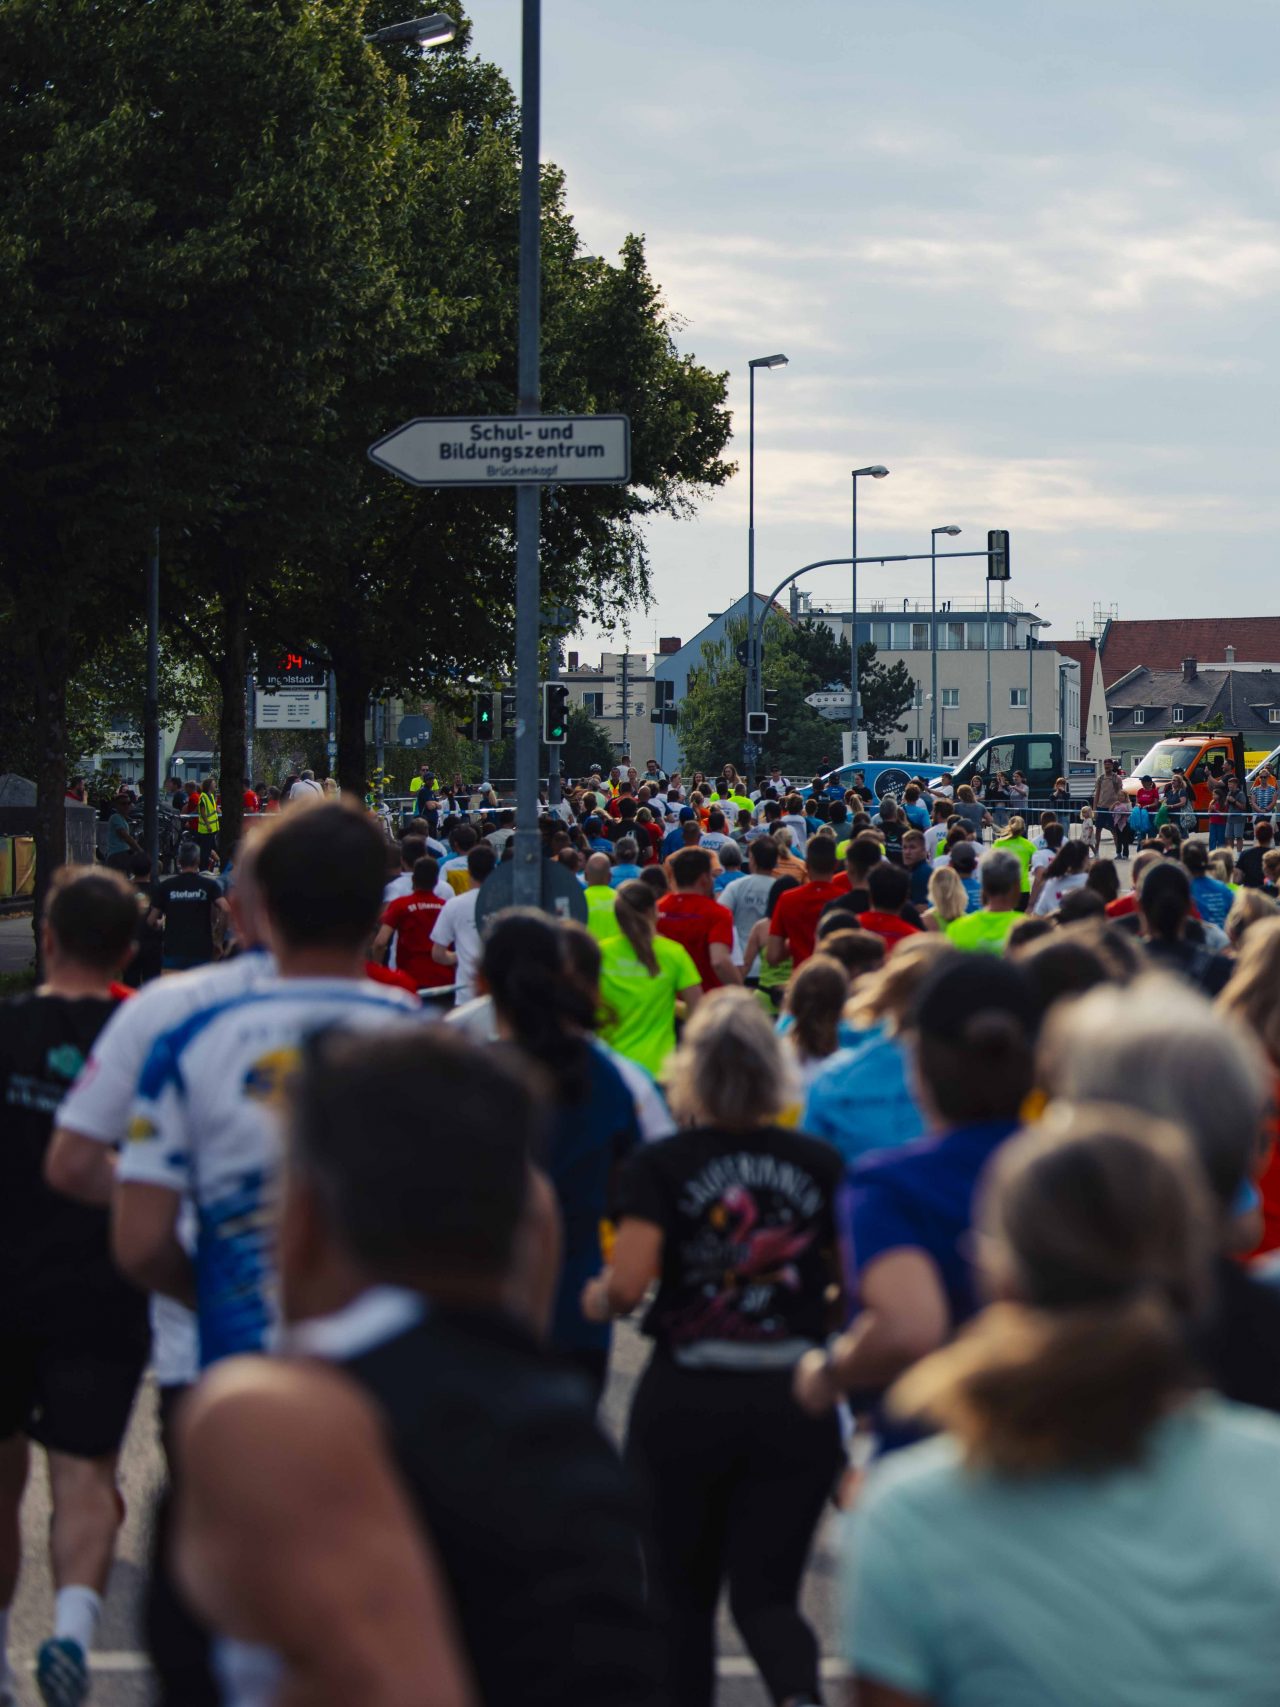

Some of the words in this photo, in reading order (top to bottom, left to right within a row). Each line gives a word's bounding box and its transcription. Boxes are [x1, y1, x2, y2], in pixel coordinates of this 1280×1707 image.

[470, 424, 532, 441] Schul-
[538, 423, 573, 440] und
[439, 442, 605, 464] Bildungszentrum
[486, 465, 558, 478] Brückenkopf
